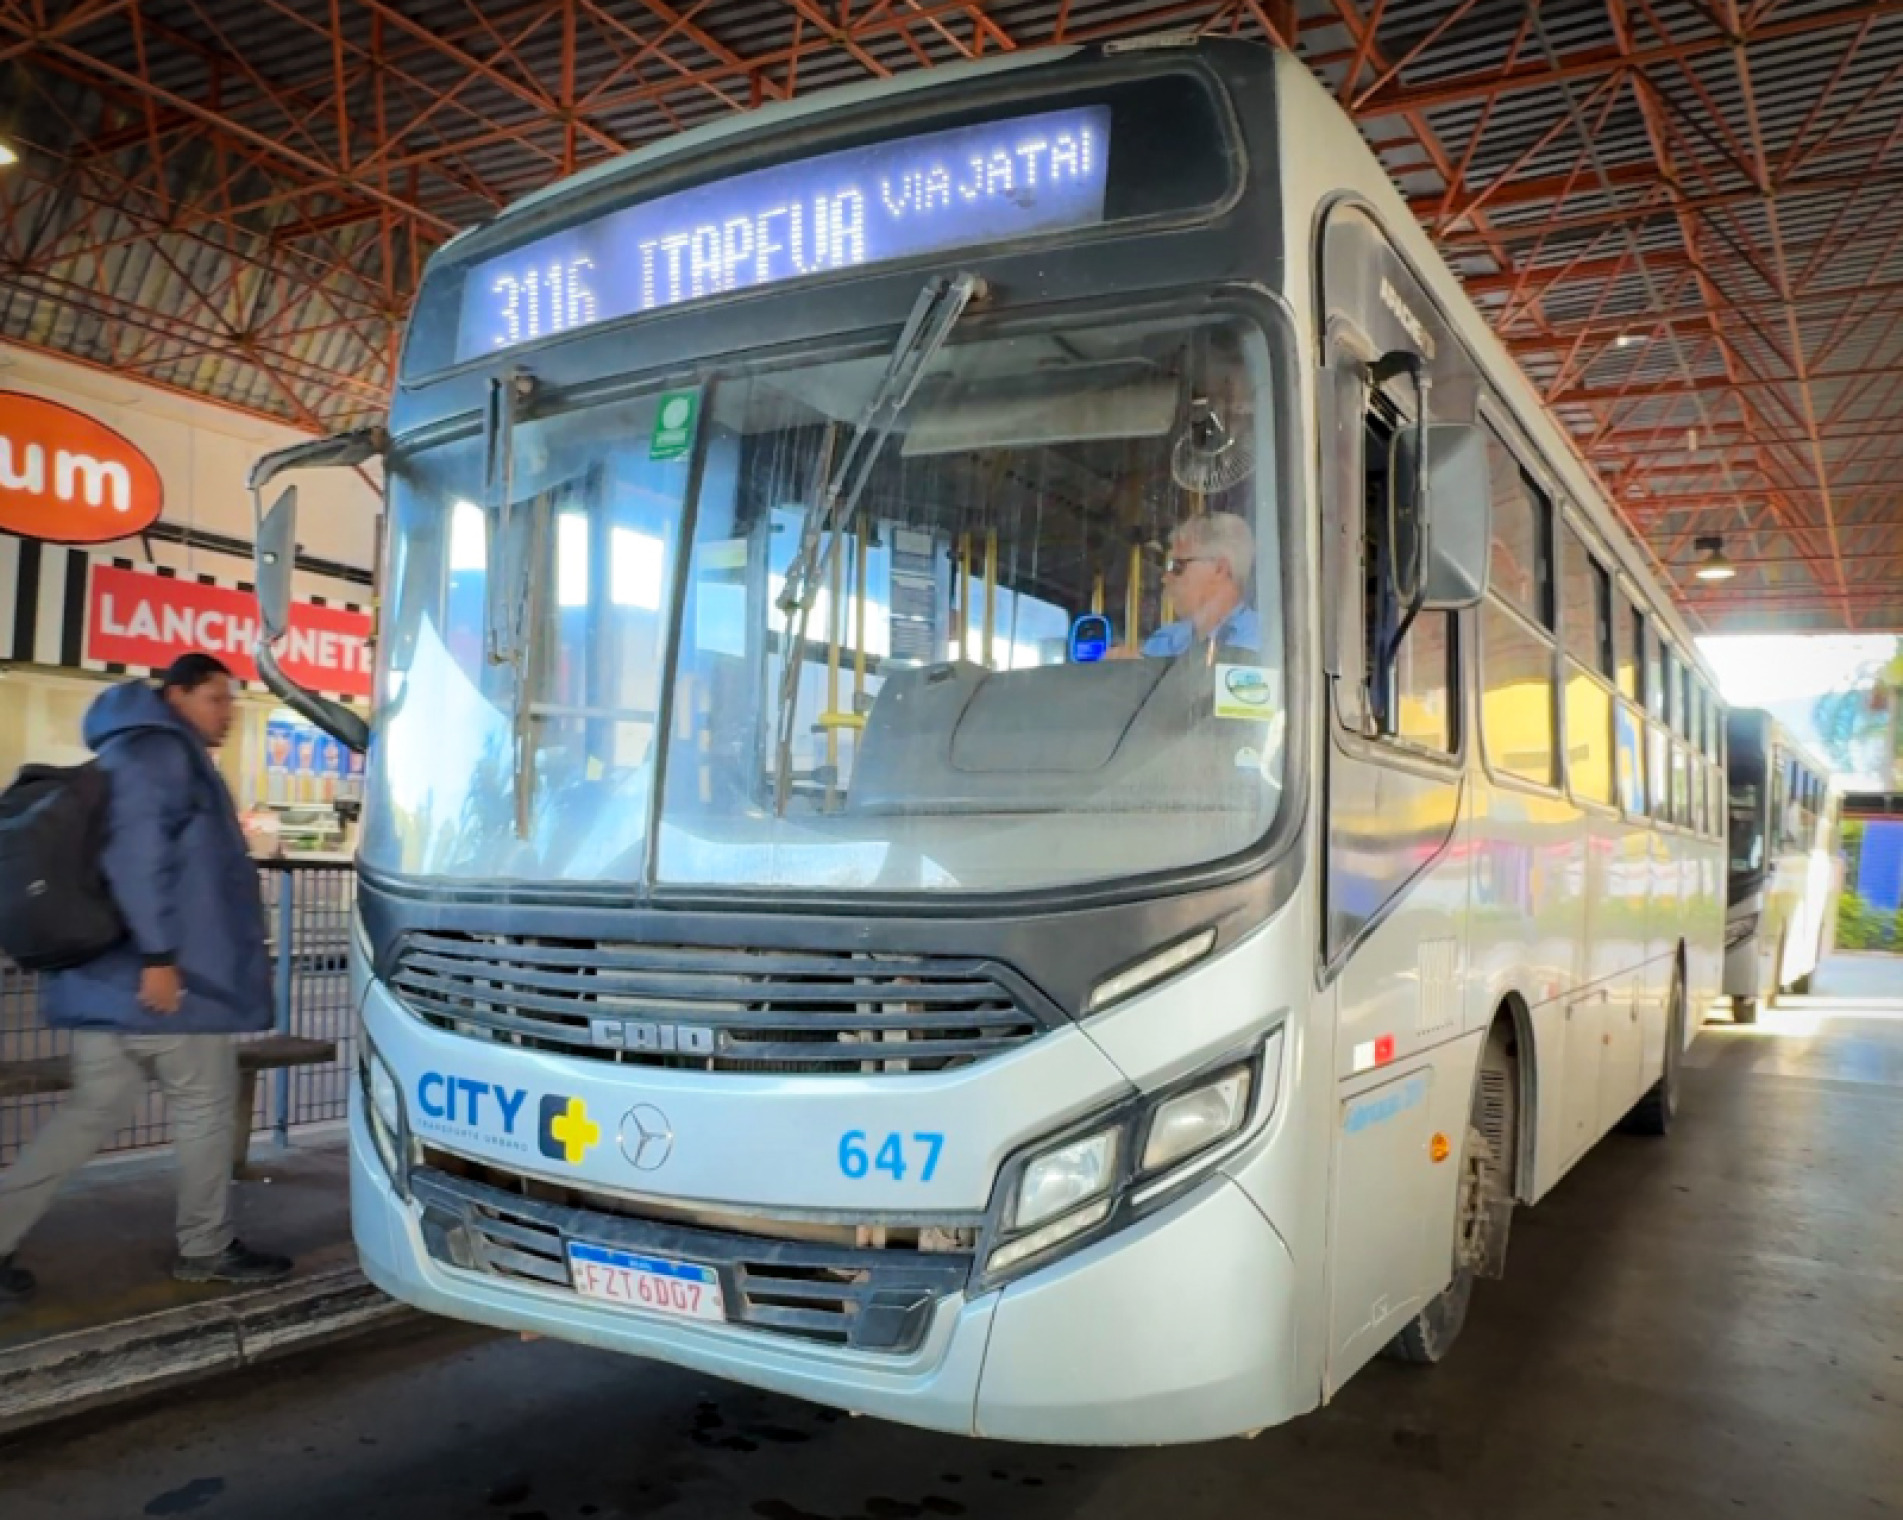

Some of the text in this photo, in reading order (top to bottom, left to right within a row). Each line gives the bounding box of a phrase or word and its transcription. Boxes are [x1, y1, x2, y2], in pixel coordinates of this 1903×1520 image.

[881, 129, 1091, 216] VIA JATAI
[492, 258, 595, 347] 3116
[592, 1020, 714, 1052] CAIO
[418, 1071, 528, 1134] CITY
[839, 1129, 944, 1183] 647
